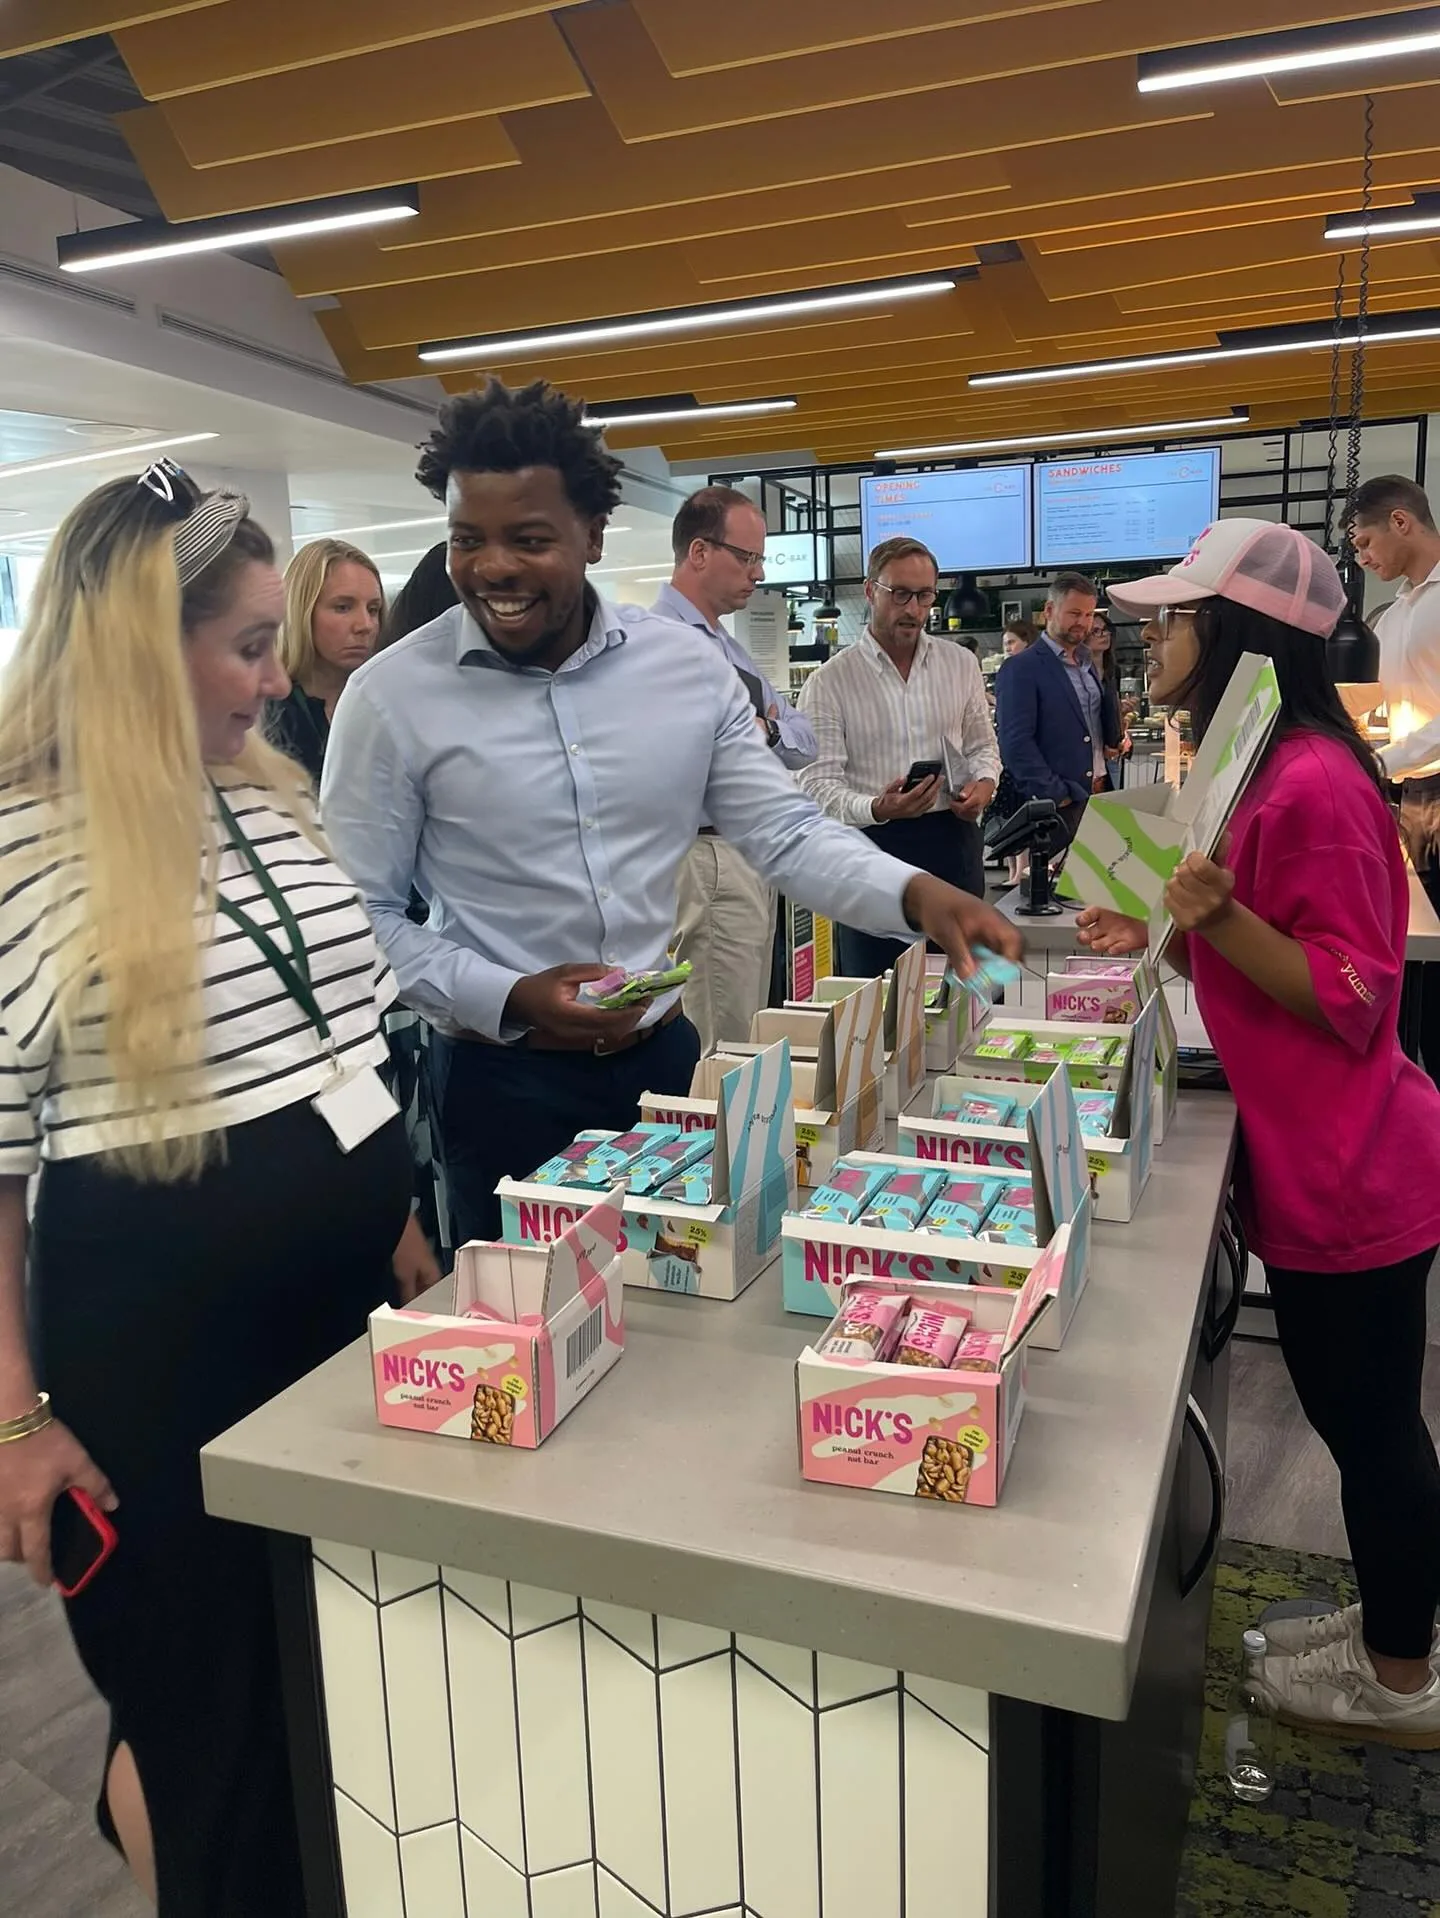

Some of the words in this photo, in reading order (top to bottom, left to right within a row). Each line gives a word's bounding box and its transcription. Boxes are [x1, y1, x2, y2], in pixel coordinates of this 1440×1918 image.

[1048, 464, 1122, 477] SANDWICHES
[875, 481, 920, 491] OPENING
[689, 1226, 707, 1237] 25%
[400, 1393, 425, 1402] peanut
[426, 1397, 452, 1406] crunch
[832, 1445, 861, 1455] peanut
[864, 1450, 894, 1459] crunch
[863, 1456, 880, 1465] bar
